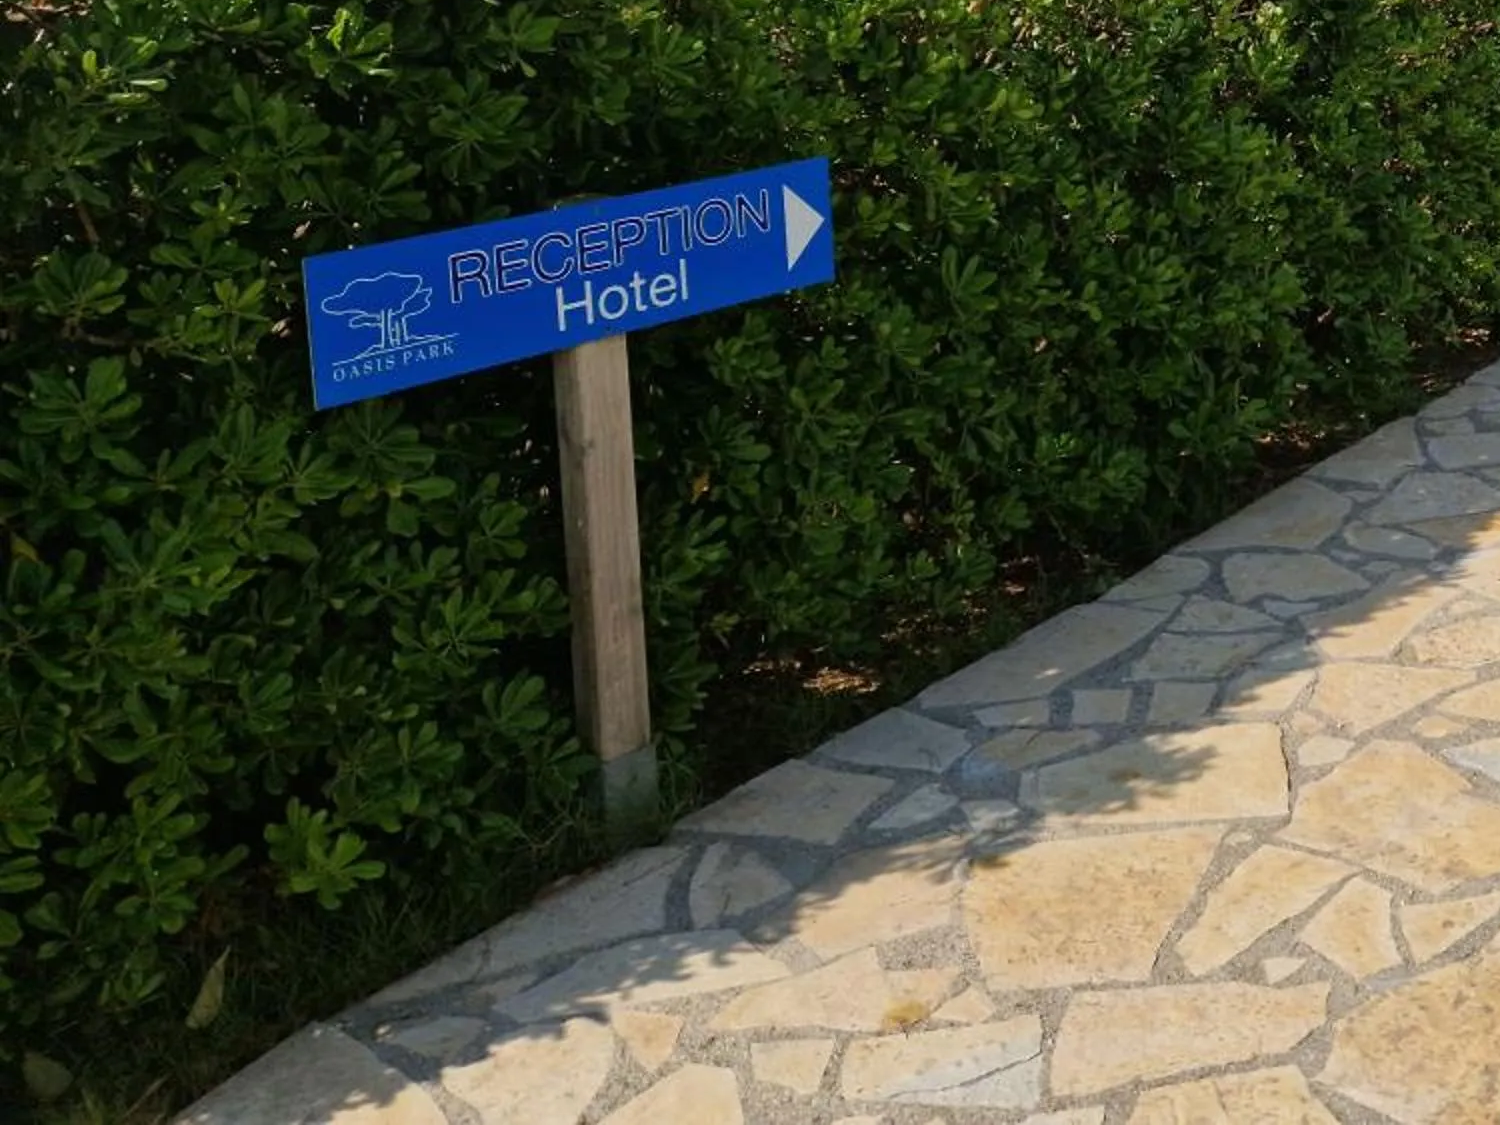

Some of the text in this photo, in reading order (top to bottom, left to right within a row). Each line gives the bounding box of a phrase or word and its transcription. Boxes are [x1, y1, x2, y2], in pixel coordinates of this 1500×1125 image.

[447, 188, 772, 304] RECEPTION
[555, 258, 689, 332] Hotel
[332, 341, 455, 382] OASIS PARK
